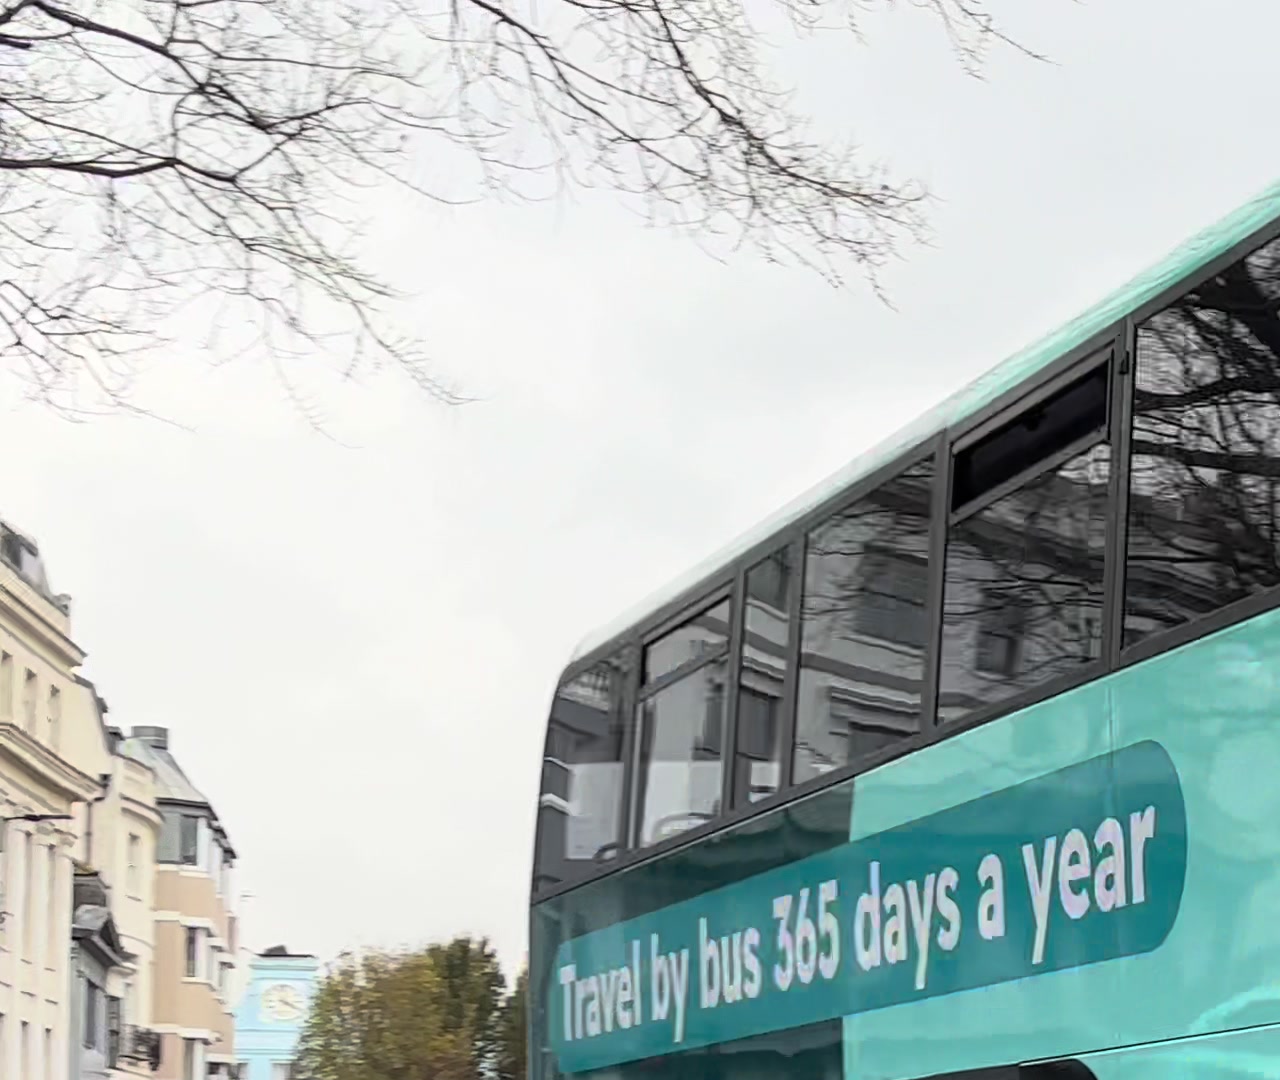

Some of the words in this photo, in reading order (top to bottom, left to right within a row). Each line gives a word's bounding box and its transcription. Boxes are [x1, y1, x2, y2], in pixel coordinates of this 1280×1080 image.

[558, 938, 641, 1042] Travel
[649, 933, 690, 1044] by
[698, 917, 762, 1009] bus
[772, 879, 840, 992] 365
[853, 860, 961, 991] days
[976, 853, 1007, 941] a
[1021, 803, 1157, 965] year
